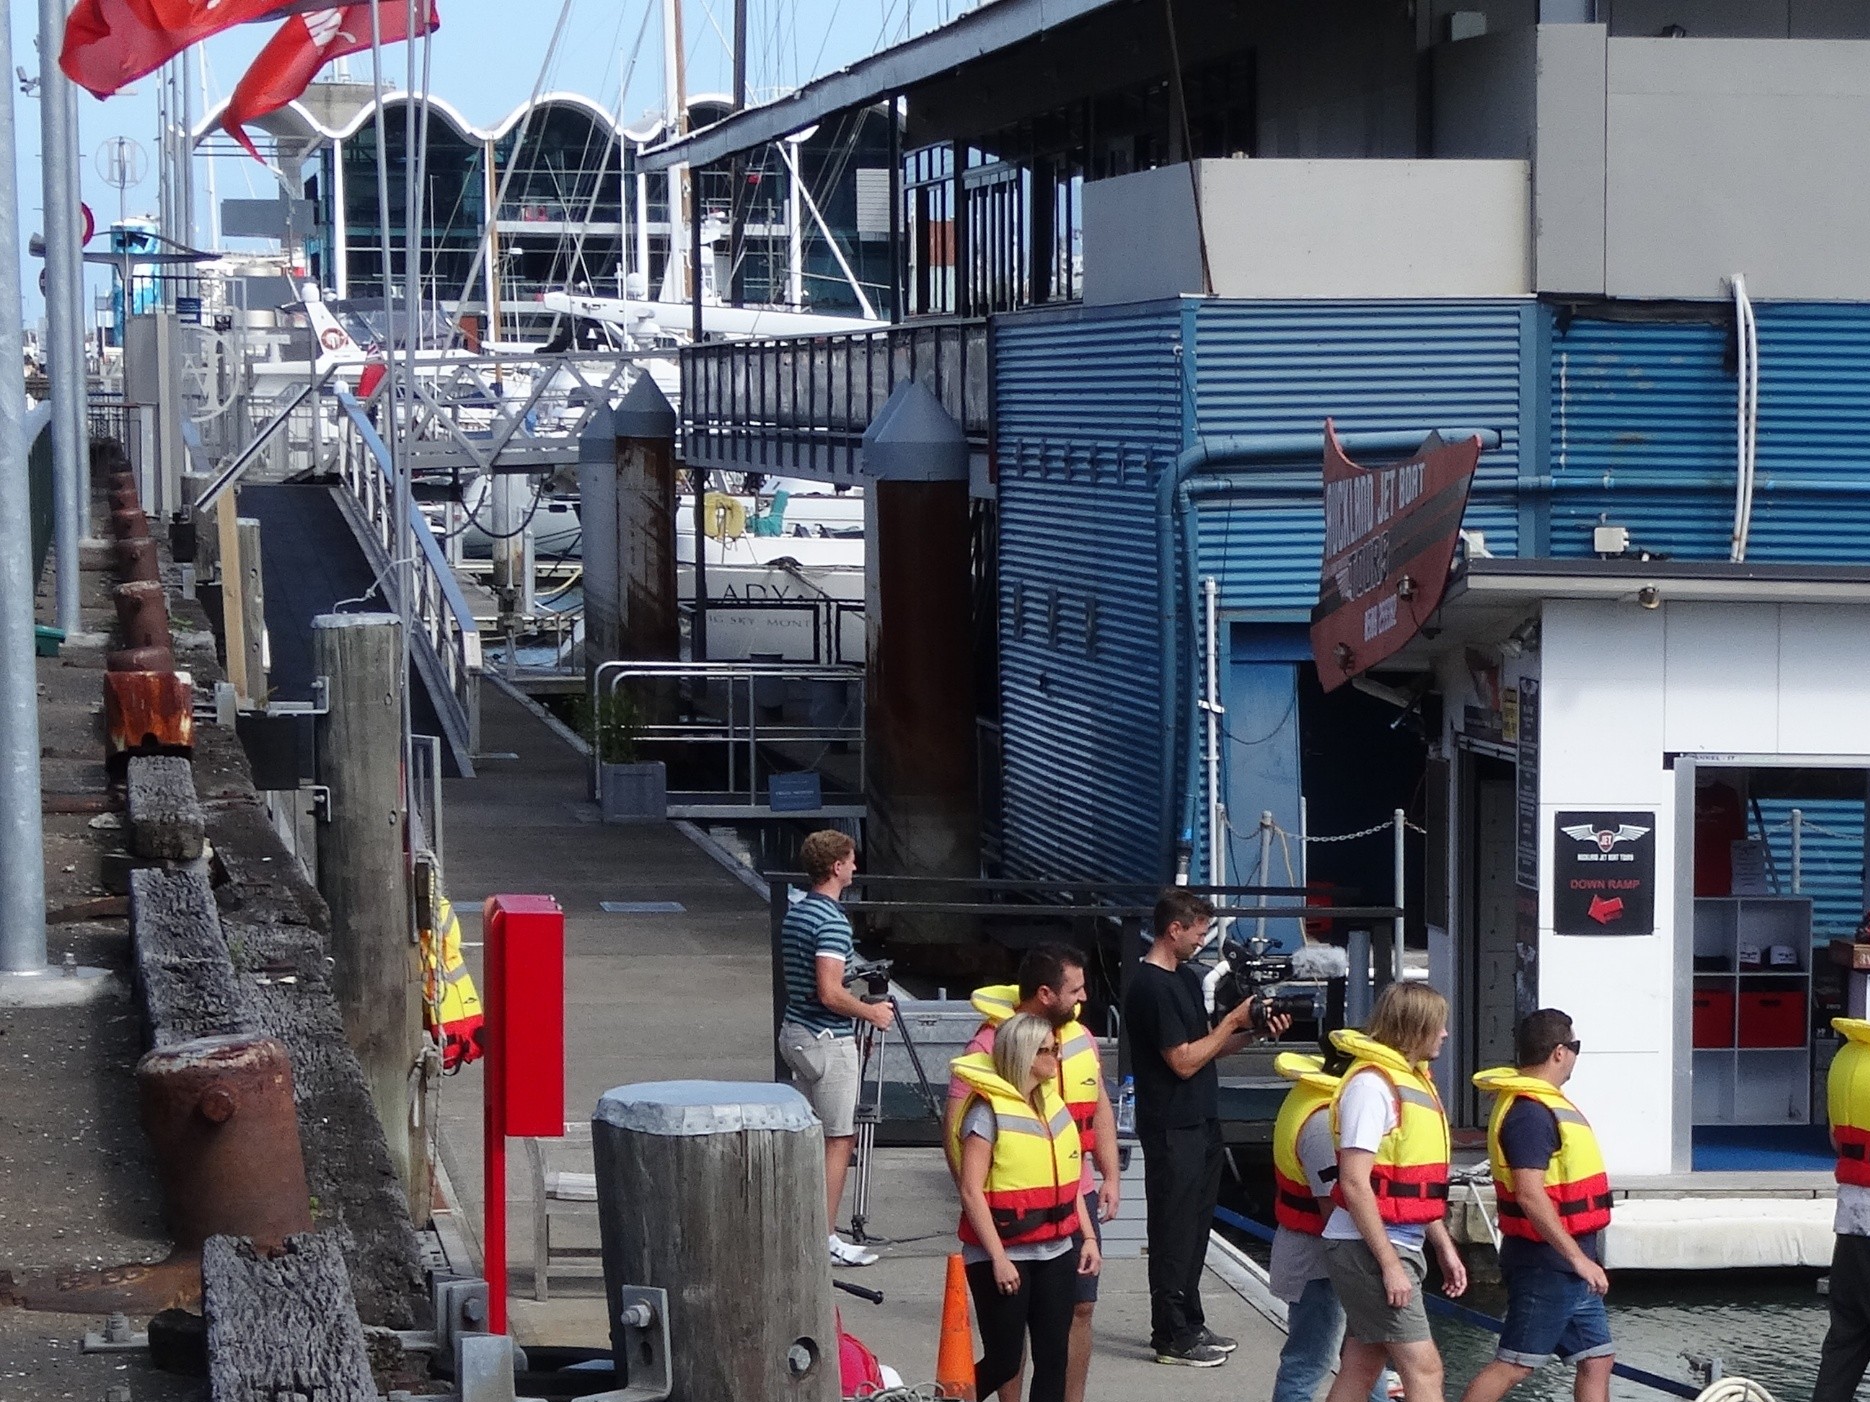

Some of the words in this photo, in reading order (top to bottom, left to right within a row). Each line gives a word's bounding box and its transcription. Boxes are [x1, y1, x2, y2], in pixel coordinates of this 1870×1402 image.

[1377, 469, 1396, 525] JET
[1398, 462, 1426, 510] BOAT
[1569, 879, 1605, 889] DOWN
[1607, 879, 1641, 889] RAMP
